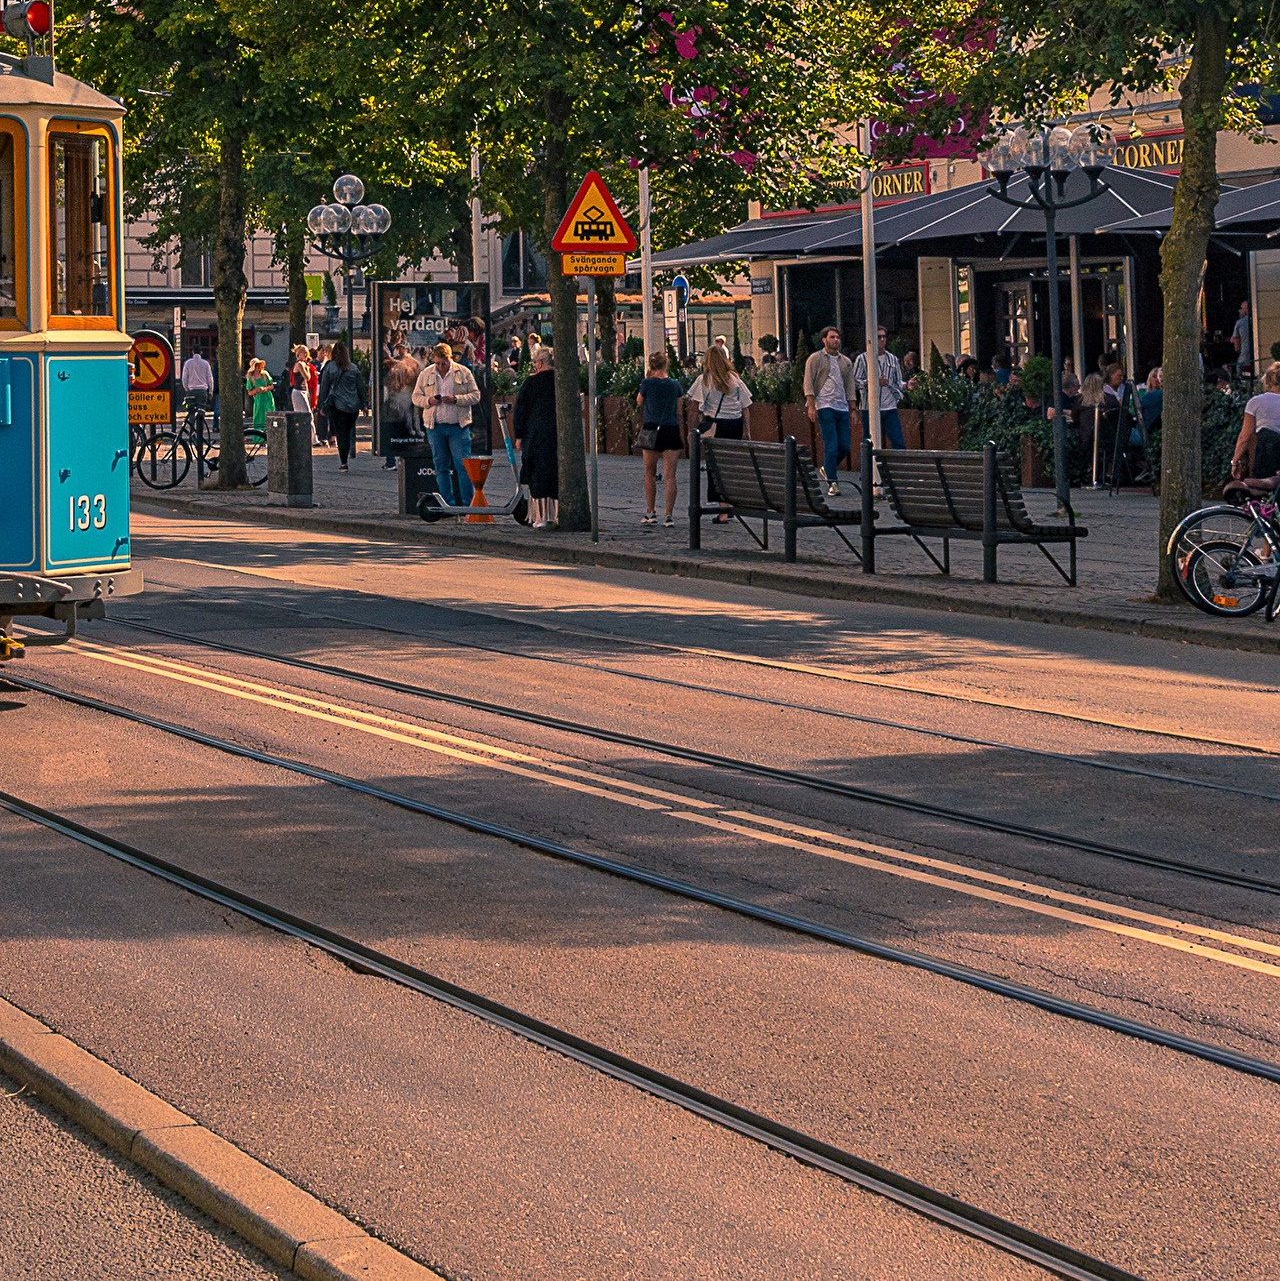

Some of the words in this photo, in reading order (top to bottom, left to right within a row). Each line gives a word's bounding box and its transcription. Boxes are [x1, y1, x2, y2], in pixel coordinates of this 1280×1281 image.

[870, 171, 924, 198] ORNER
[570, 256, 617, 264] Svängande
[574, 265, 614, 273] spårvagn
[389, 297, 415, 316] Hej
[667, 293, 673, 312] B
[390, 316, 449, 335] vardag!
[156, 393, 166, 402] ej
[144, 412, 168, 422] cykel
[417, 467, 454, 476] JCDex
[69, 493, 107, 532] 133
